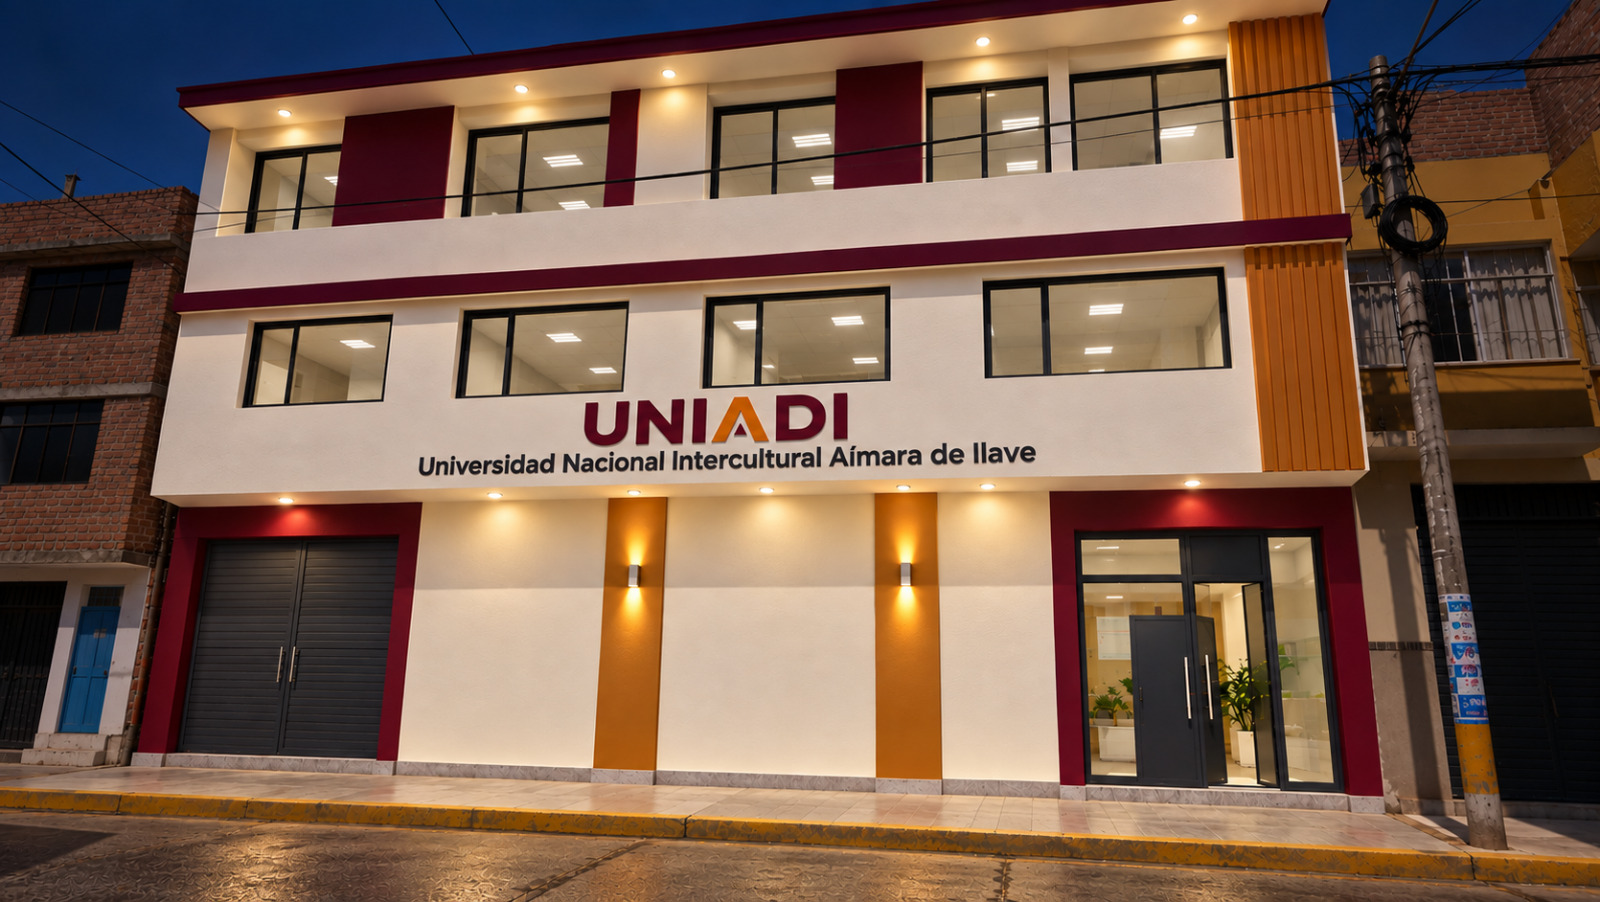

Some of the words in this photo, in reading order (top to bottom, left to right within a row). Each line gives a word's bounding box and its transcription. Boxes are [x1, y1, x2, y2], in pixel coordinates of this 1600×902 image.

[584, 392, 849, 446] UNIADI
[418, 453, 555, 476] Universidad
[562, 451, 665, 473] Nacional
[672, 446, 822, 471] Intercultural
[829, 445, 922, 467] Aímara
[931, 443, 965, 465] de
[973, 442, 1036, 464] Ilave
